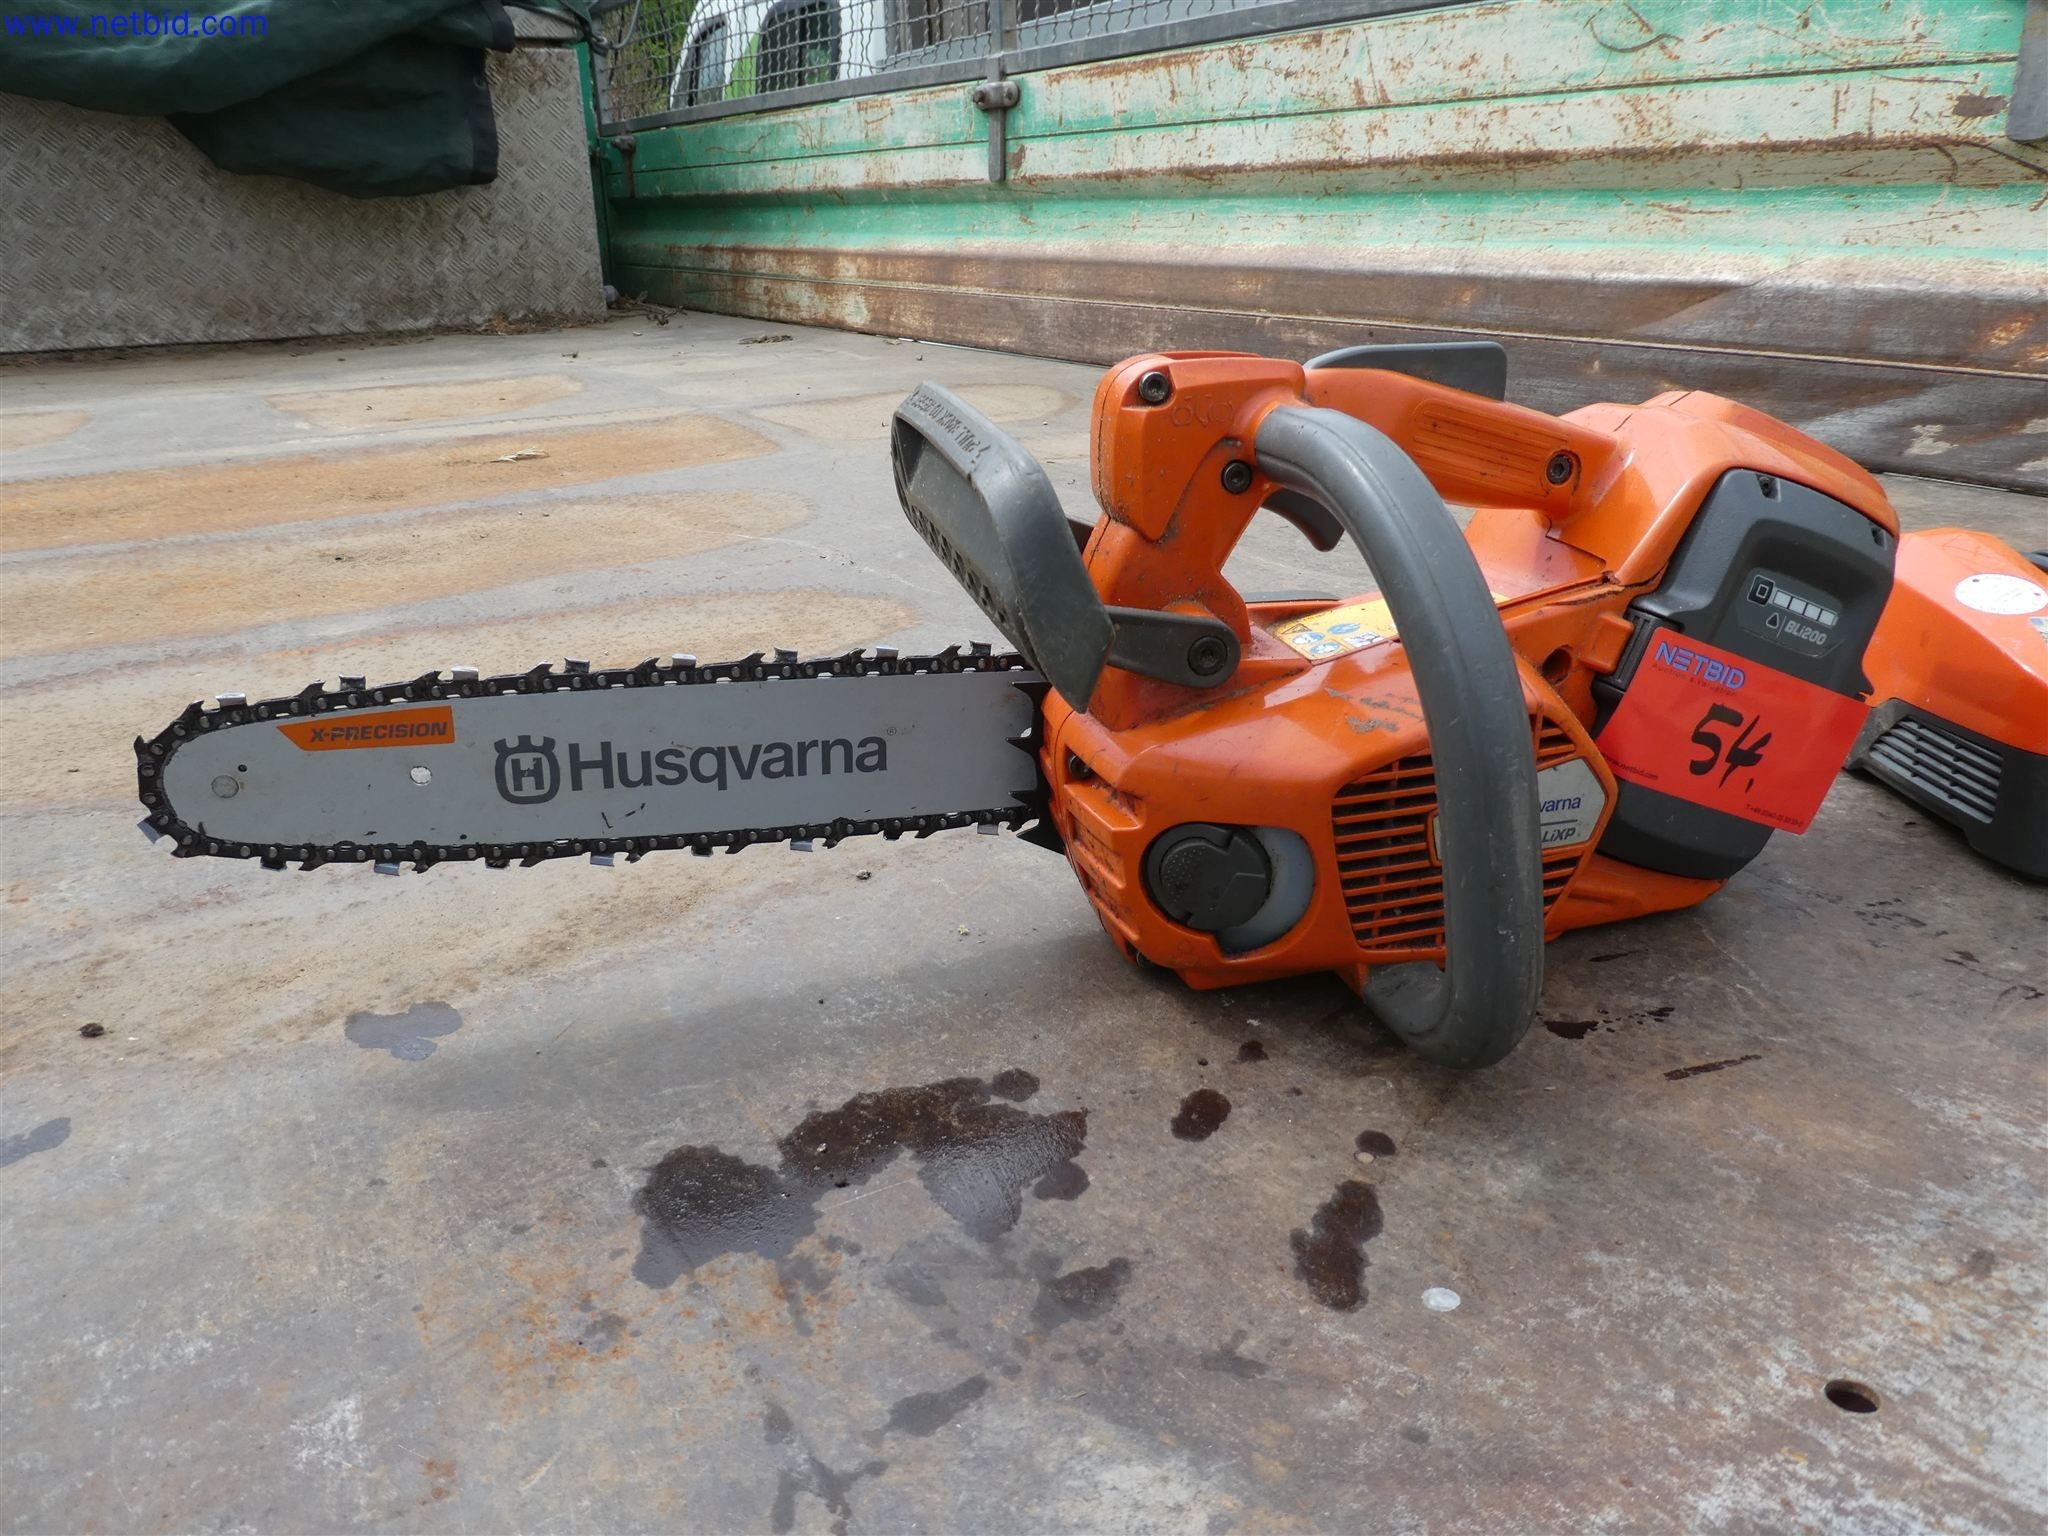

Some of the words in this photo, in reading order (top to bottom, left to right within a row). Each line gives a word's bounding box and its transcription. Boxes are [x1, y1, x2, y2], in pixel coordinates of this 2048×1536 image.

[1783, 620, 1828, 646] BLi200
[1654, 640, 1746, 690] NETBID
[309, 721, 449, 743] X-PRECISION
[568, 735, 888, 792] Husqvarna
[1540, 797, 1582, 813] varna
